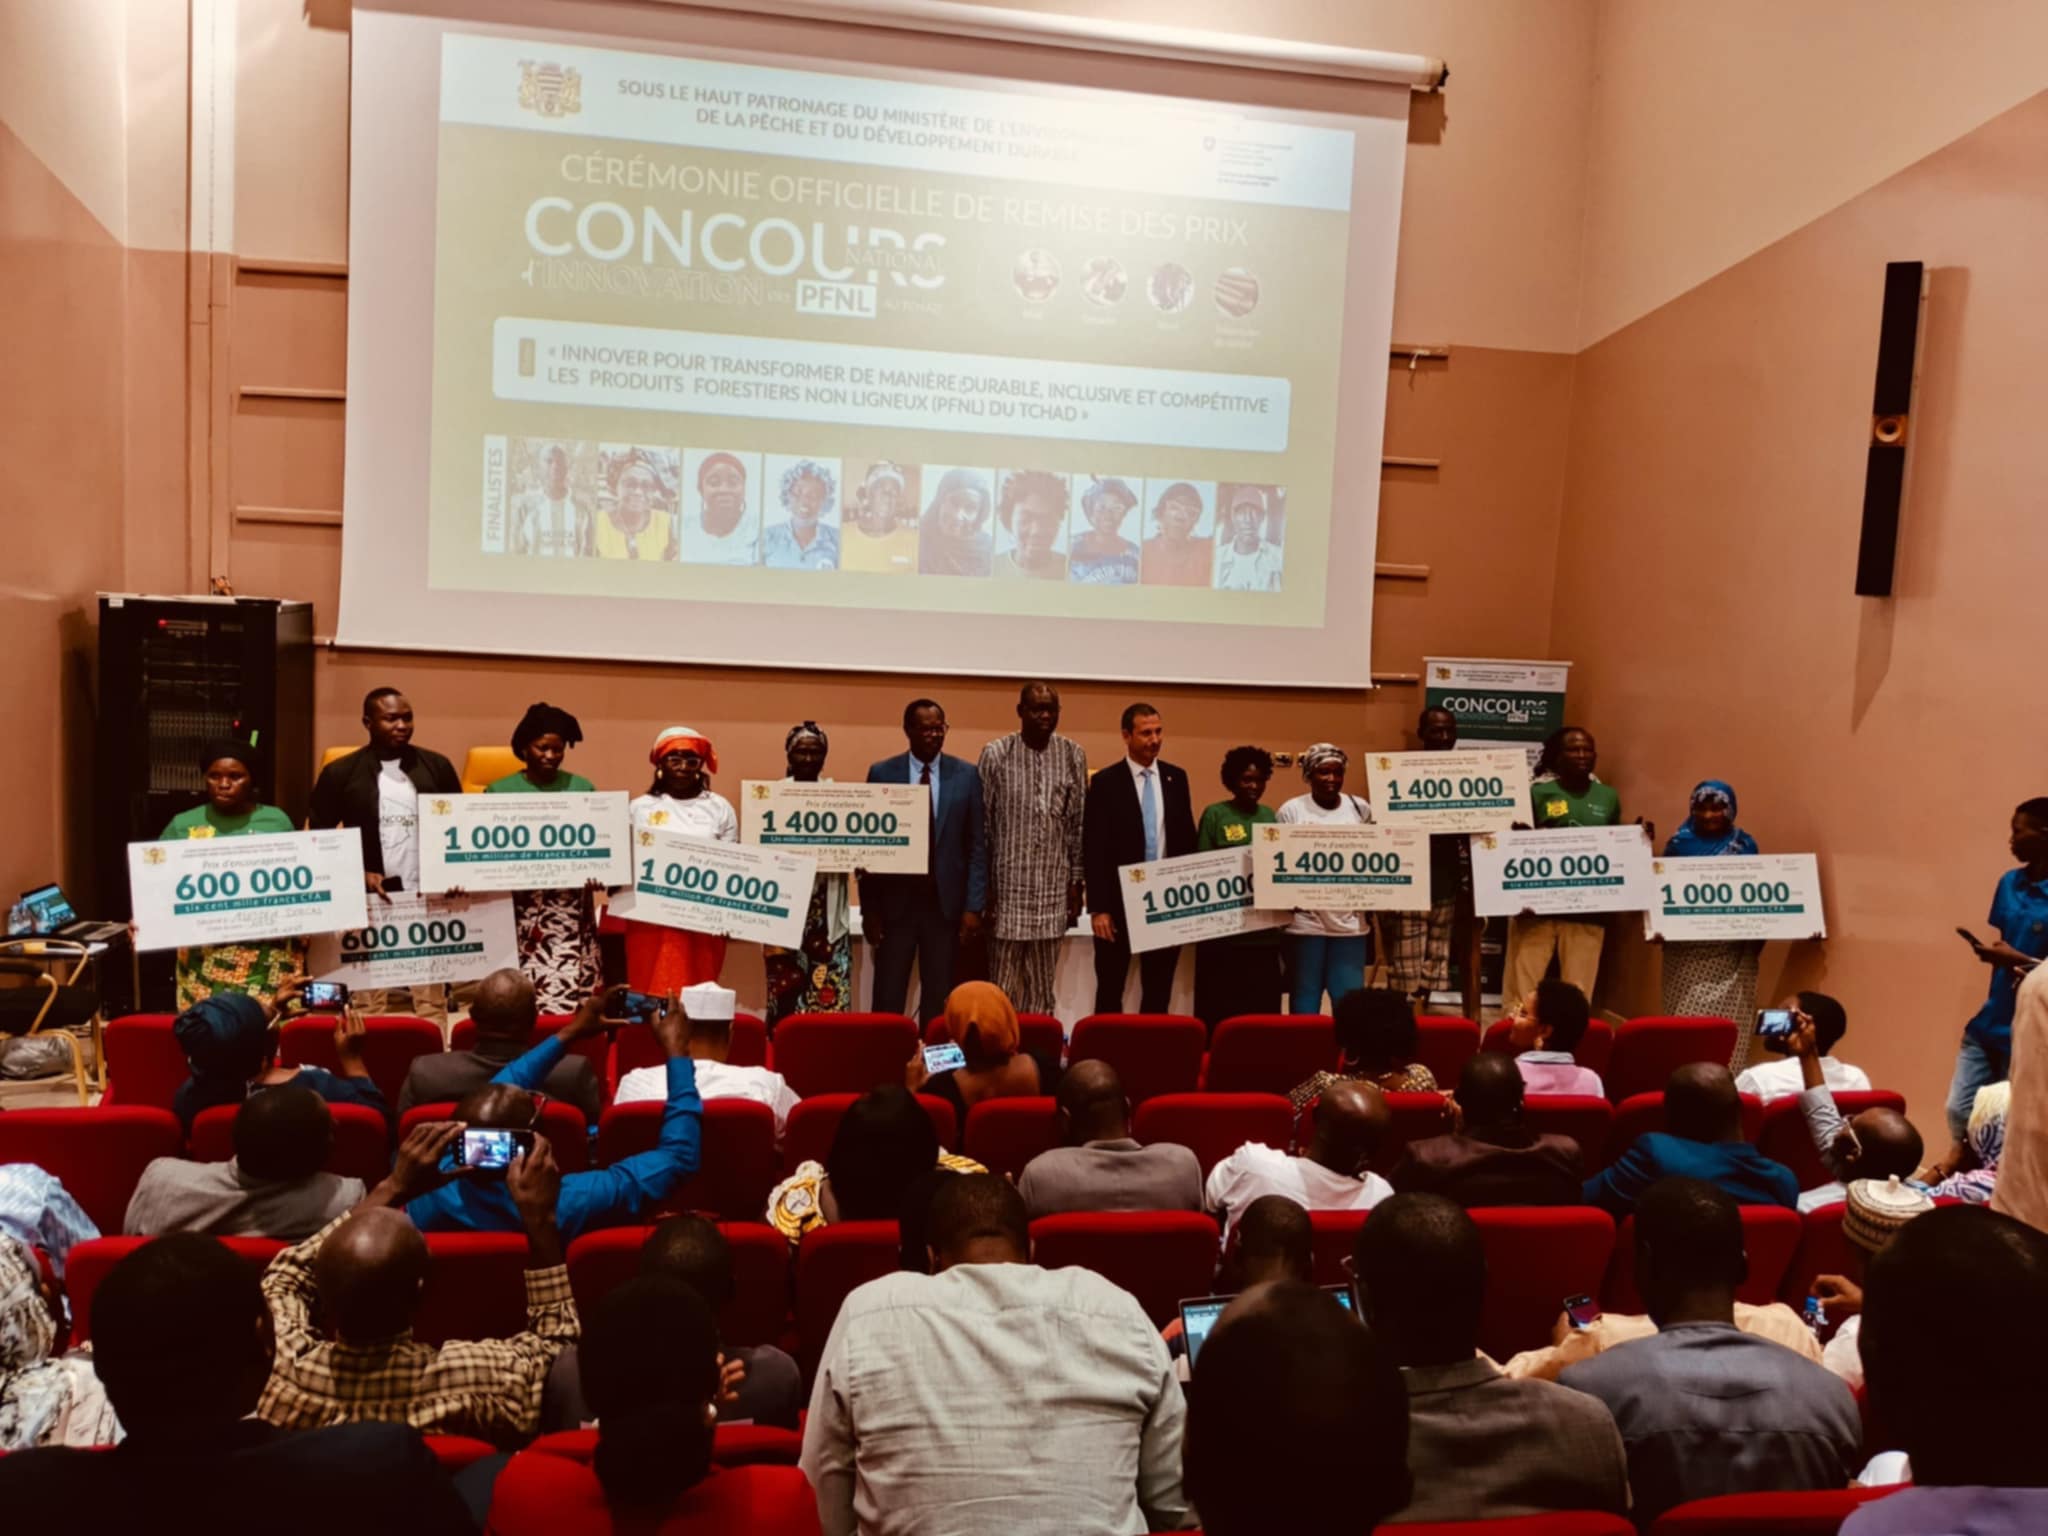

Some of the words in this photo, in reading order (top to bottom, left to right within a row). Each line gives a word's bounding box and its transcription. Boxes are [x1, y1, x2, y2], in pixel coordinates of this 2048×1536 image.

[617, 79, 665, 98] SOUS
[669, 84, 689, 101] LE
[693, 88, 743, 107] HAUT
[747, 93, 848, 118] PATRONAGE
[853, 104, 879, 121] DU
[883, 108, 968, 132] MINISTÈRE
[974, 118, 994, 135] DE
[696, 108, 719, 126] DE
[724, 112, 745, 128] LA
[750, 113, 807, 135] PÊCHE
[808, 121, 828, 137] ET
[833, 124, 858, 141] DU
[863, 126, 1002, 155] DÉVELOPPEMENT
[560, 149, 760, 199] CÉRÉMONIE
[769, 174, 945, 217] OFFICIELLE
[953, 192, 993, 224] DE
[1004, 197, 1112, 234] REMISE
[1119, 208, 1177, 241] DES
[1184, 216, 1250, 247] PRIX
[524, 196, 947, 289] CONCOURS
[802, 285, 871, 313] PFNL
[561, 344, 648, 367] INNOVER
[653, 351, 705, 371] POUR
[711, 355, 845, 383] TRANSFORMER
[850, 367, 874, 385] DE
[879, 369, 956, 391] MANIÈRE
[1048, 383, 1132, 405] INCLUSIVE
[1137, 390, 1157, 406] ET
[1160, 391, 1269, 414] COMPÉTITIVE
[547, 367, 579, 385] LES
[590, 369, 684, 393] PRODUITS
[694, 377, 800, 401] FORESTIERS
[805, 387, 847, 405] NON
[852, 391, 928, 411] LIGNEUX
[932, 396, 984, 417] (PFNL)
[989, 400, 1015, 417] DU
[1020, 404, 1077, 422] TCHAD
[487, 447, 503, 540] FINALISTES
[1442, 696, 1548, 716] CONCOURS
[1388, 780, 1401, 800] 1
[1408, 778, 1452, 799] 400
[1459, 777, 1503, 798] 000
[444, 826, 461, 850] 1
[471, 825, 530, 849] 000
[539, 823, 596, 847] 000
[762, 810, 776, 832] 1
[785, 811, 838, 833] 400
[845, 811, 897, 834] 000
[203, 861, 219, 869] Prix
[520, 850, 533, 858] de
[1273, 852, 1287, 872] 1
[1295, 852, 1344, 872] 400
[1352, 852, 1400, 873] 000
[1504, 857, 1552, 879] 600
[1560, 854, 1610, 876] 000
[176, 871, 240, 901] 600
[250, 866, 313, 894] 000
[640, 858, 655, 881] 1
[664, 863, 718, 892] 000
[725, 873, 779, 903] 000
[1660, 884, 1676, 905] 1
[1683, 883, 1733, 904] 000
[1740, 882, 1790, 903] 000
[204, 901, 229, 911] cent
[232, 898, 259, 908] mille
[1143, 890, 1158, 912] 1
[1164, 882, 1210, 908] 000
[341, 925, 399, 950] 600
[408, 920, 466, 945] 000
